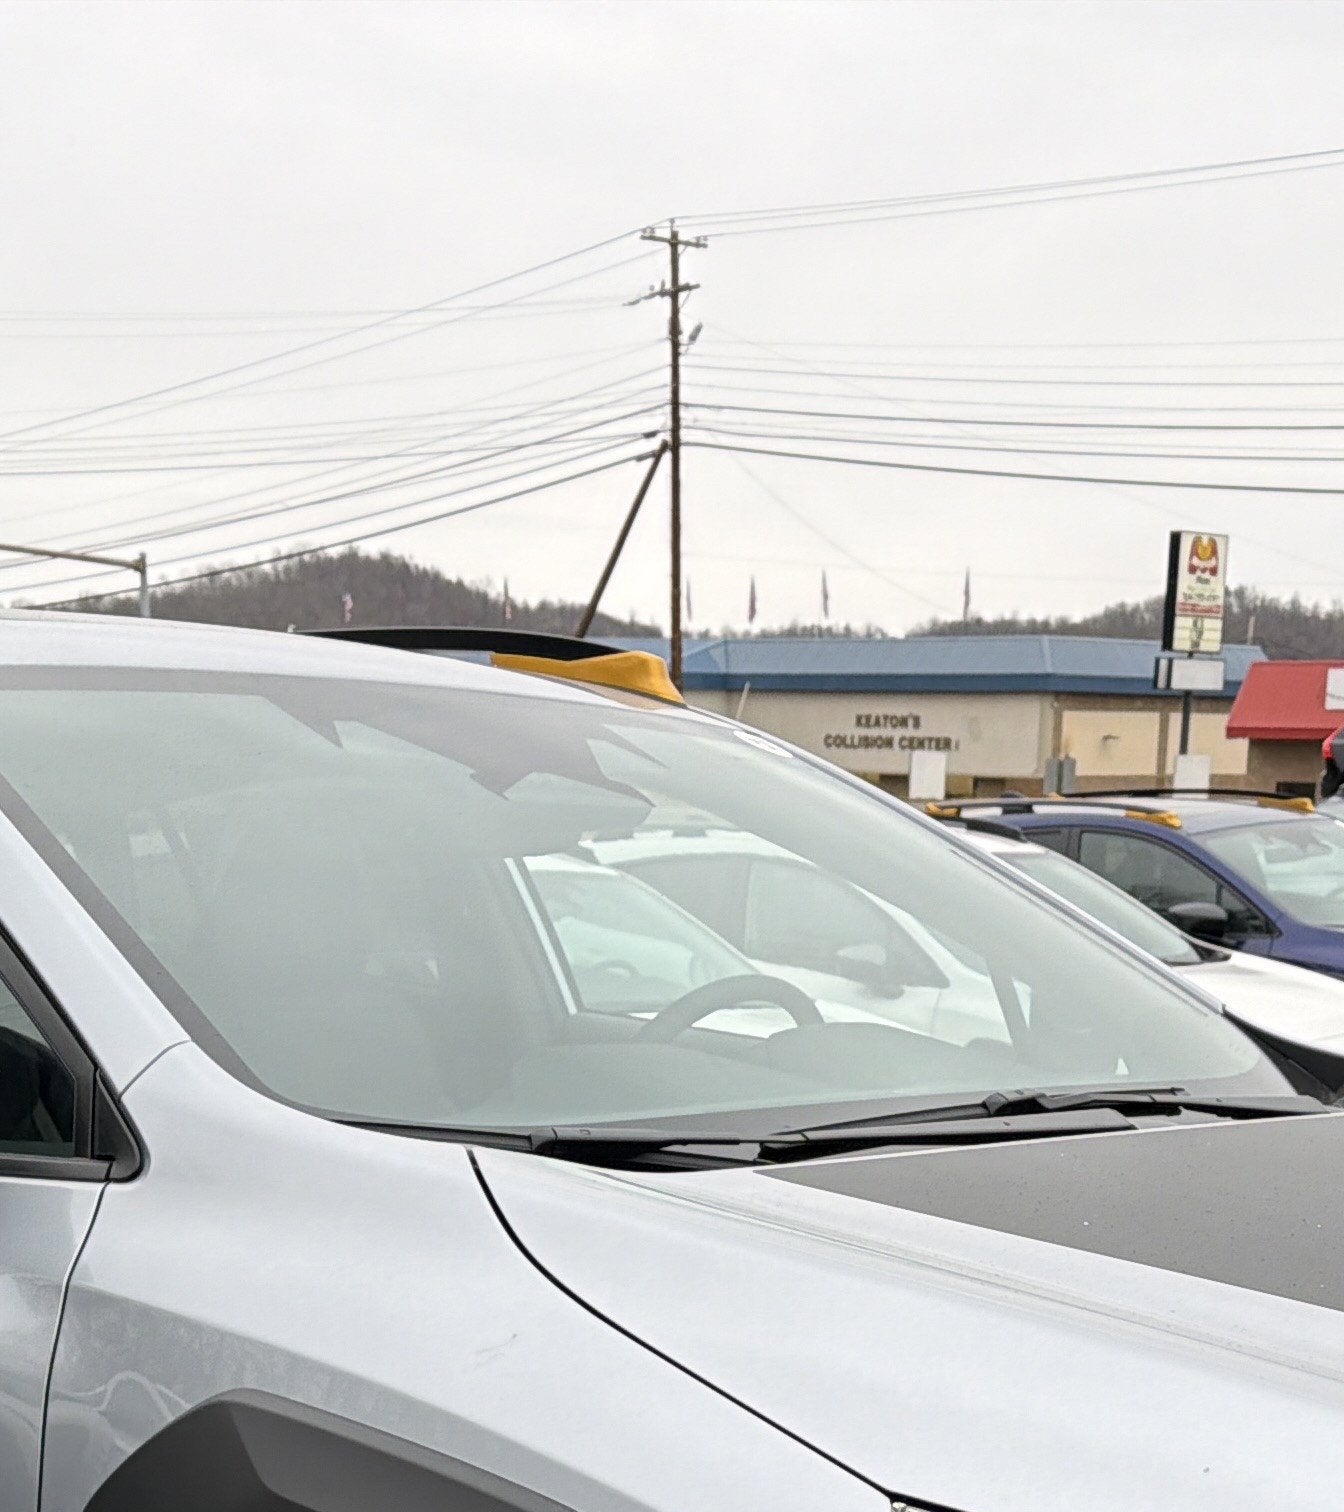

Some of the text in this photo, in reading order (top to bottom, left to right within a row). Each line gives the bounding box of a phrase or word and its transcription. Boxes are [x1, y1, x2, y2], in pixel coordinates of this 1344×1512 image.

[856, 713, 921, 729] KEATON'S
[823, 733, 952, 750] COLLISION CENTER
